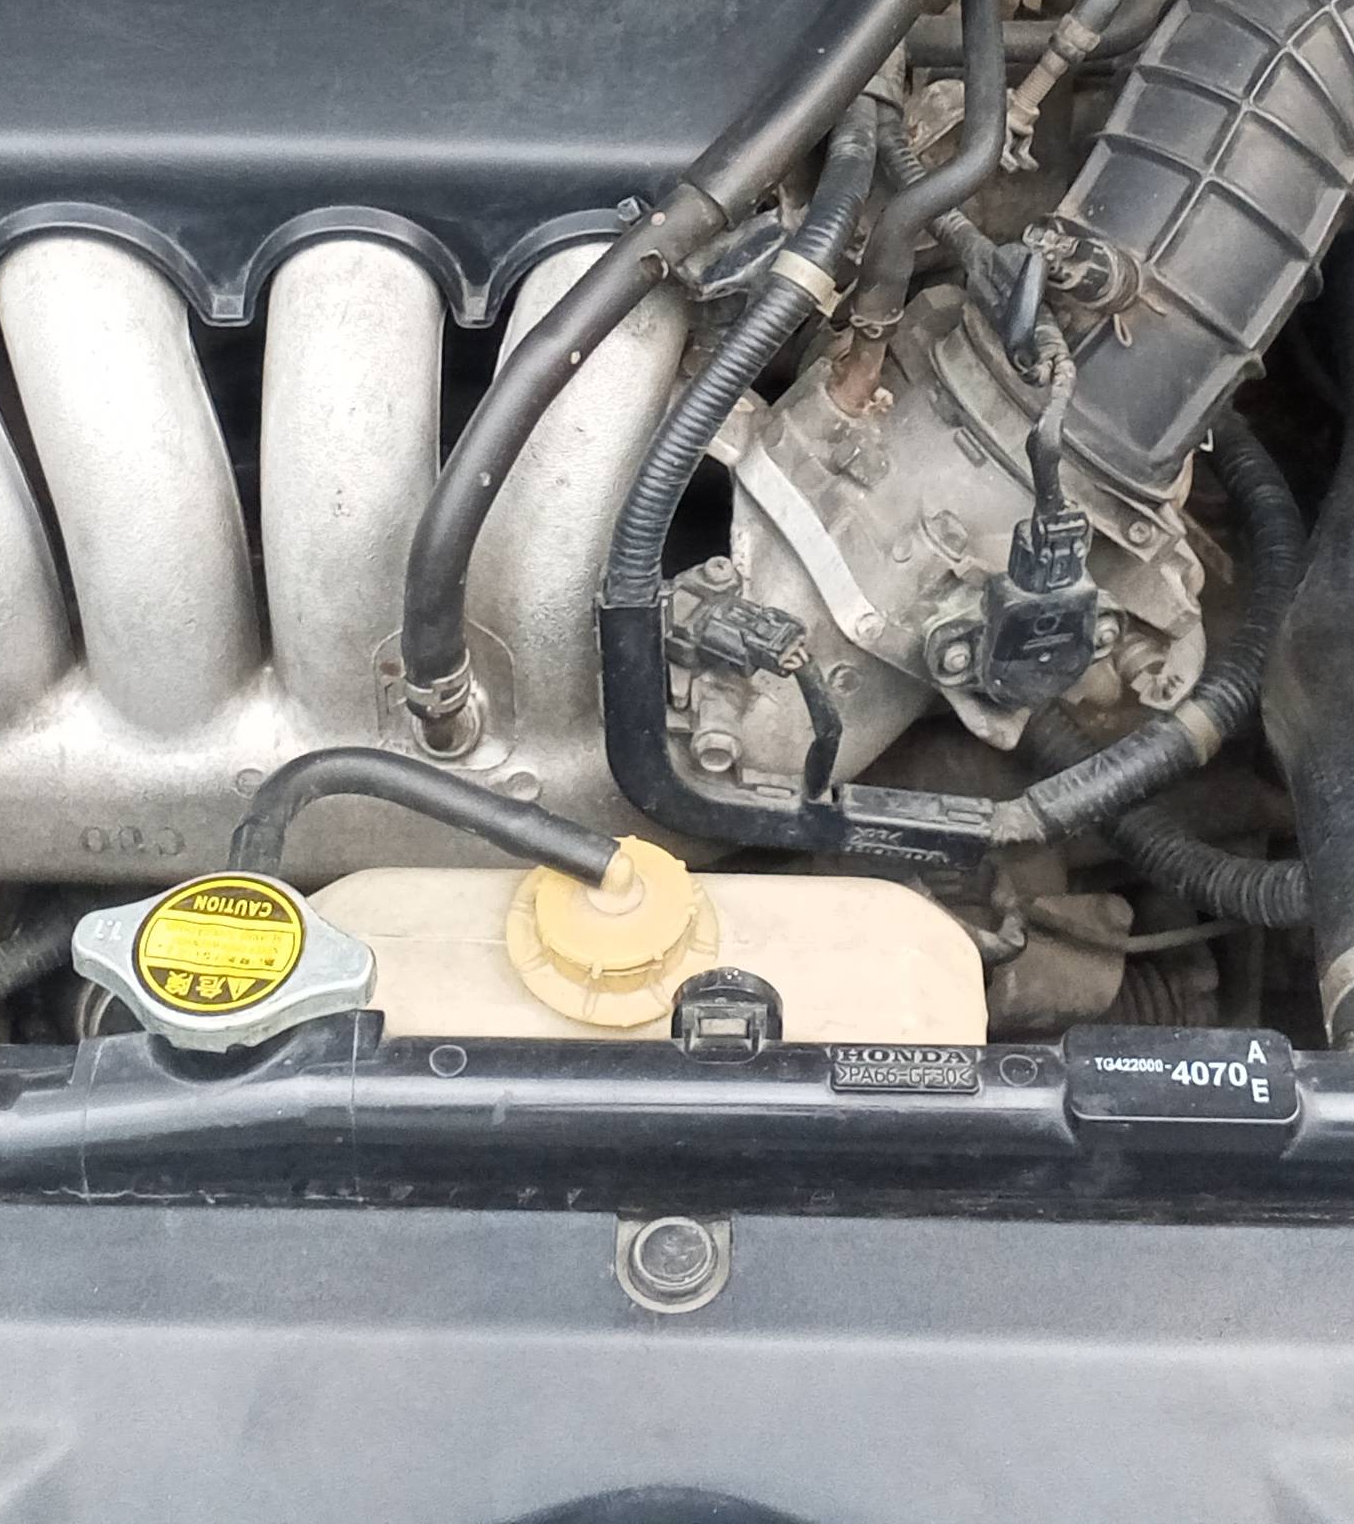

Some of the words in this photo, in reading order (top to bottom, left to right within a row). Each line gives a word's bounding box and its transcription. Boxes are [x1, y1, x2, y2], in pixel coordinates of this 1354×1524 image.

[192, 893, 274, 918] CAUTION
[840, 1049, 971, 1064] HONDA
[1246, 1039, 1268, 1065] A
[1250, 1077, 1271, 1104] E
